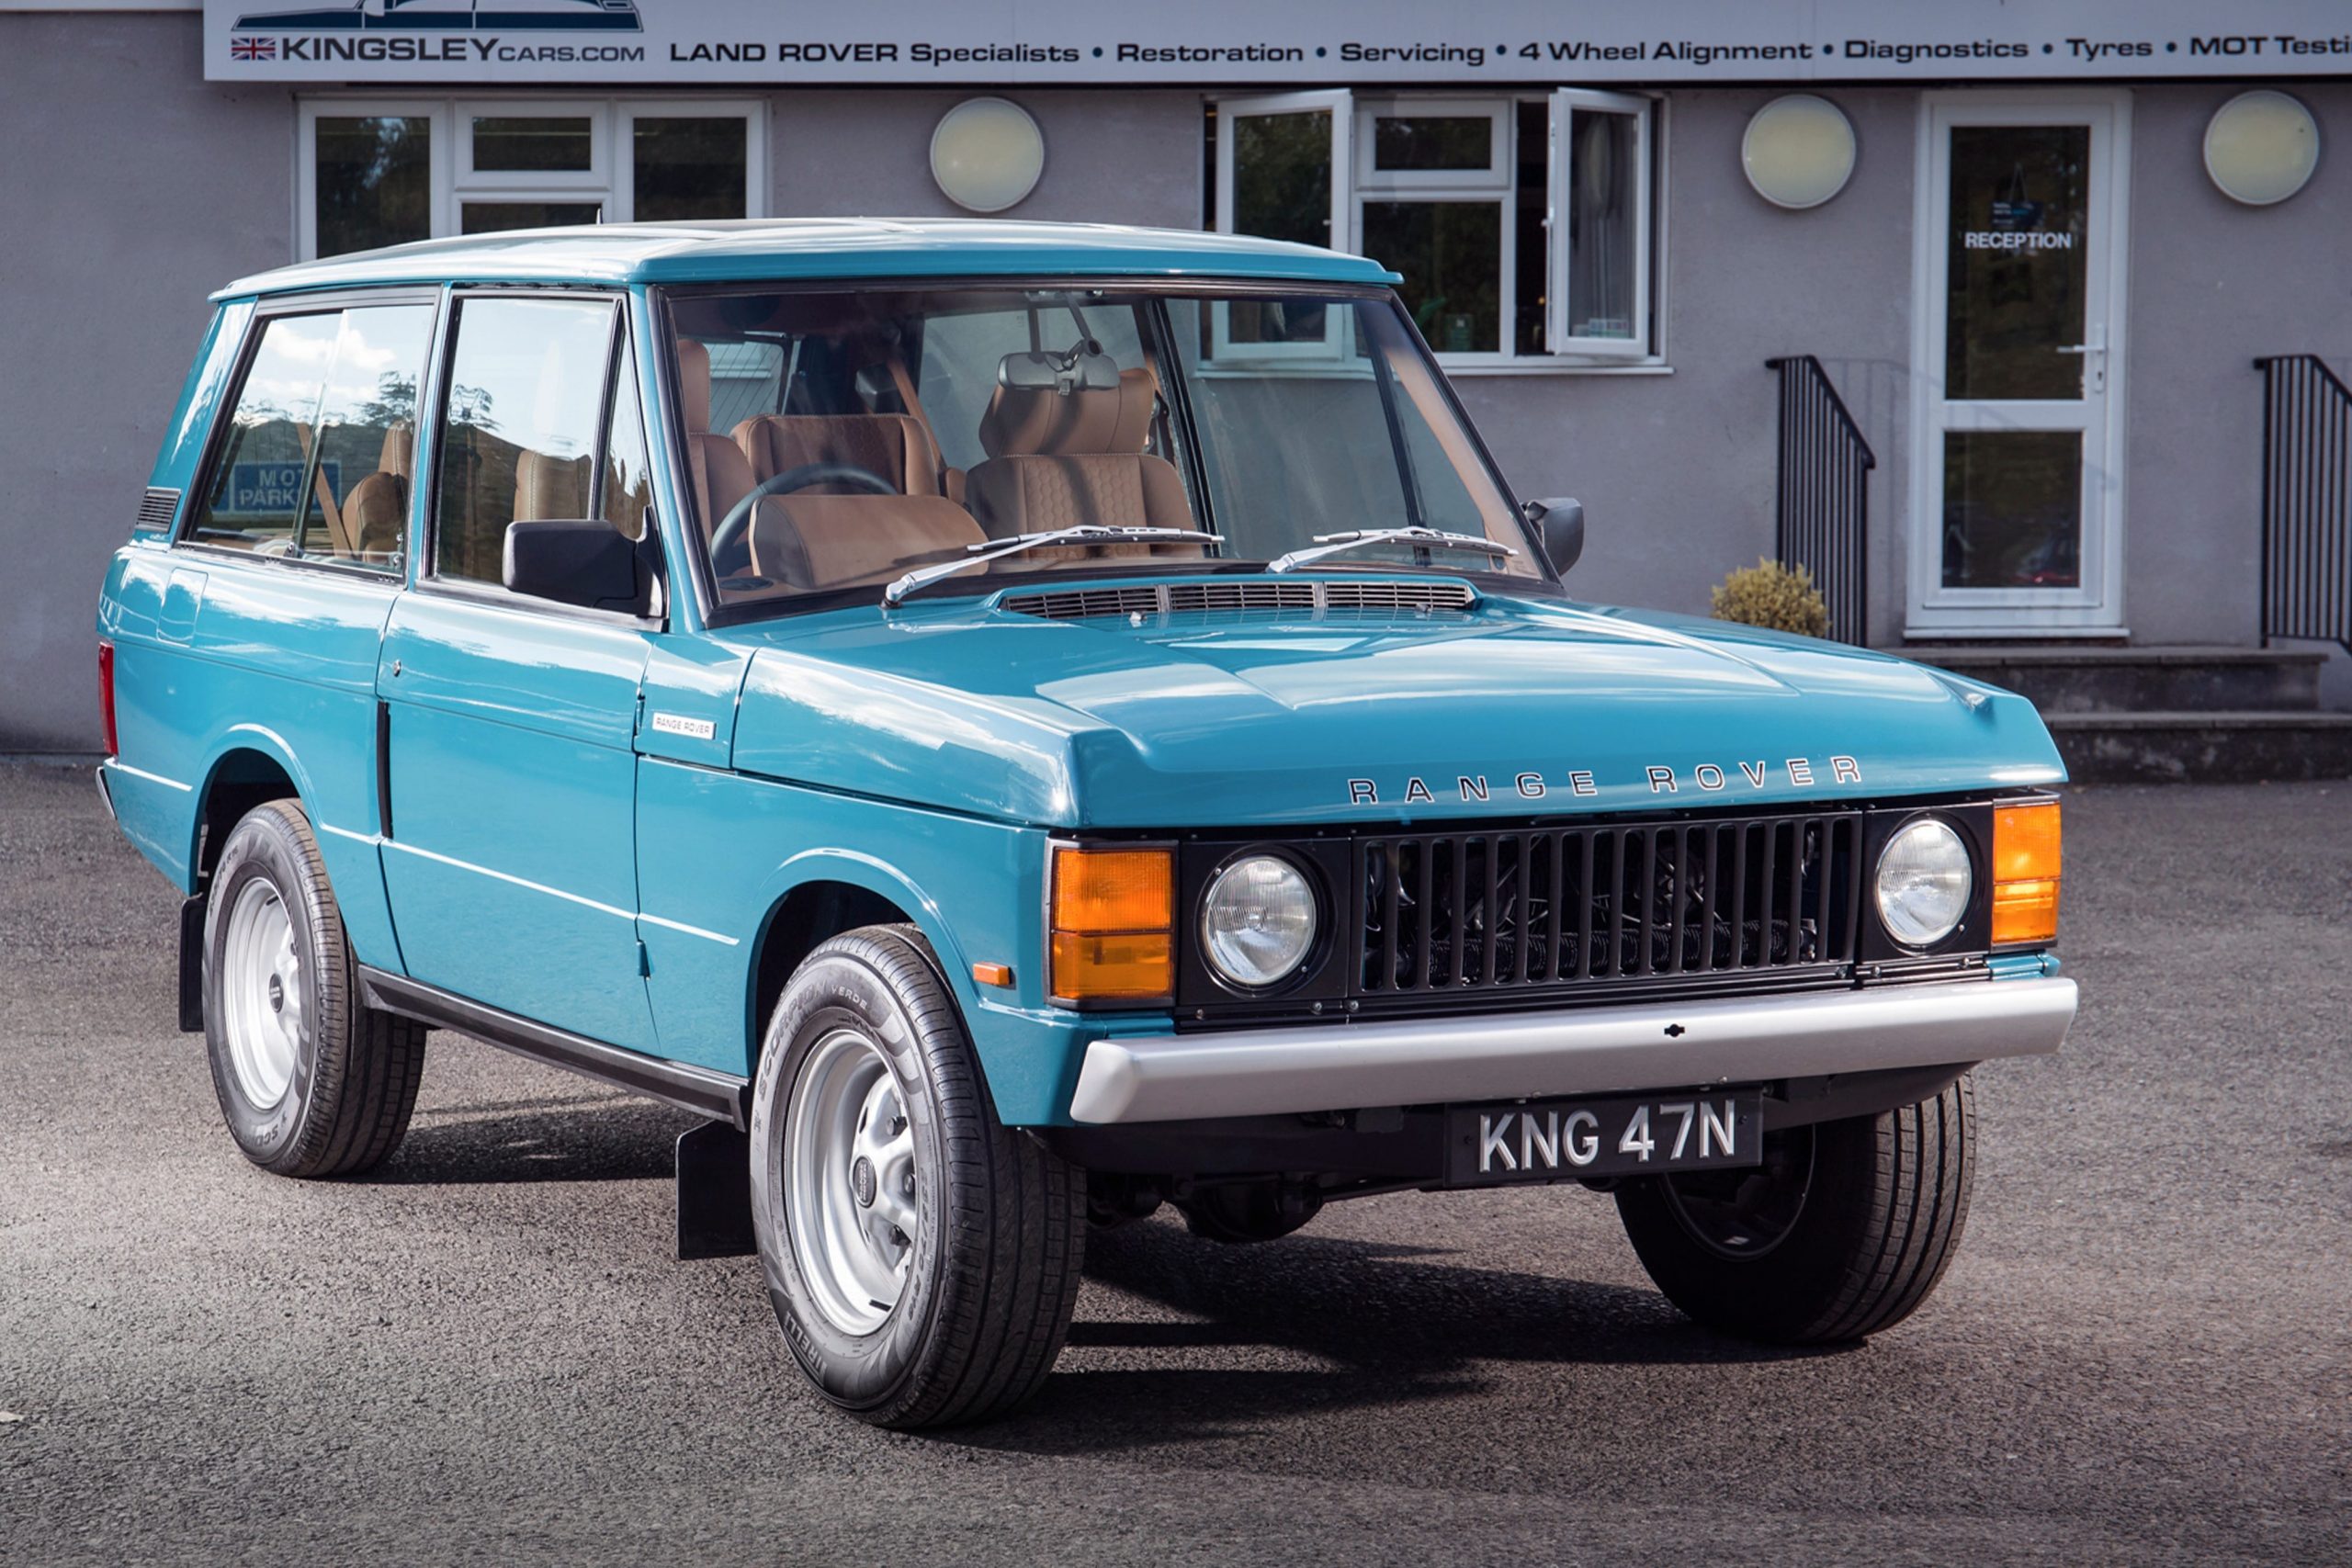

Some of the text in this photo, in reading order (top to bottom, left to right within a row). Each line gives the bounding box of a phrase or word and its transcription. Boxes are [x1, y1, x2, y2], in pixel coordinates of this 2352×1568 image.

[281, 37, 645, 62] KINGSLEYCARS.COM
[670, 35, 2352, 67] LAND ROVER Specialists Restoration Servicing 4 Wheel Alignment Diagnostics Tyres MOT Testi
[1964, 231, 2072, 249] RECEPTION
[657, 716, 711, 734] RANGE ROVER
[1347, 754, 1862, 806] RANGE ROVER
[831, 984, 868, 1010] VERDE
[1479, 1100, 1736, 1173] KNG 47N
